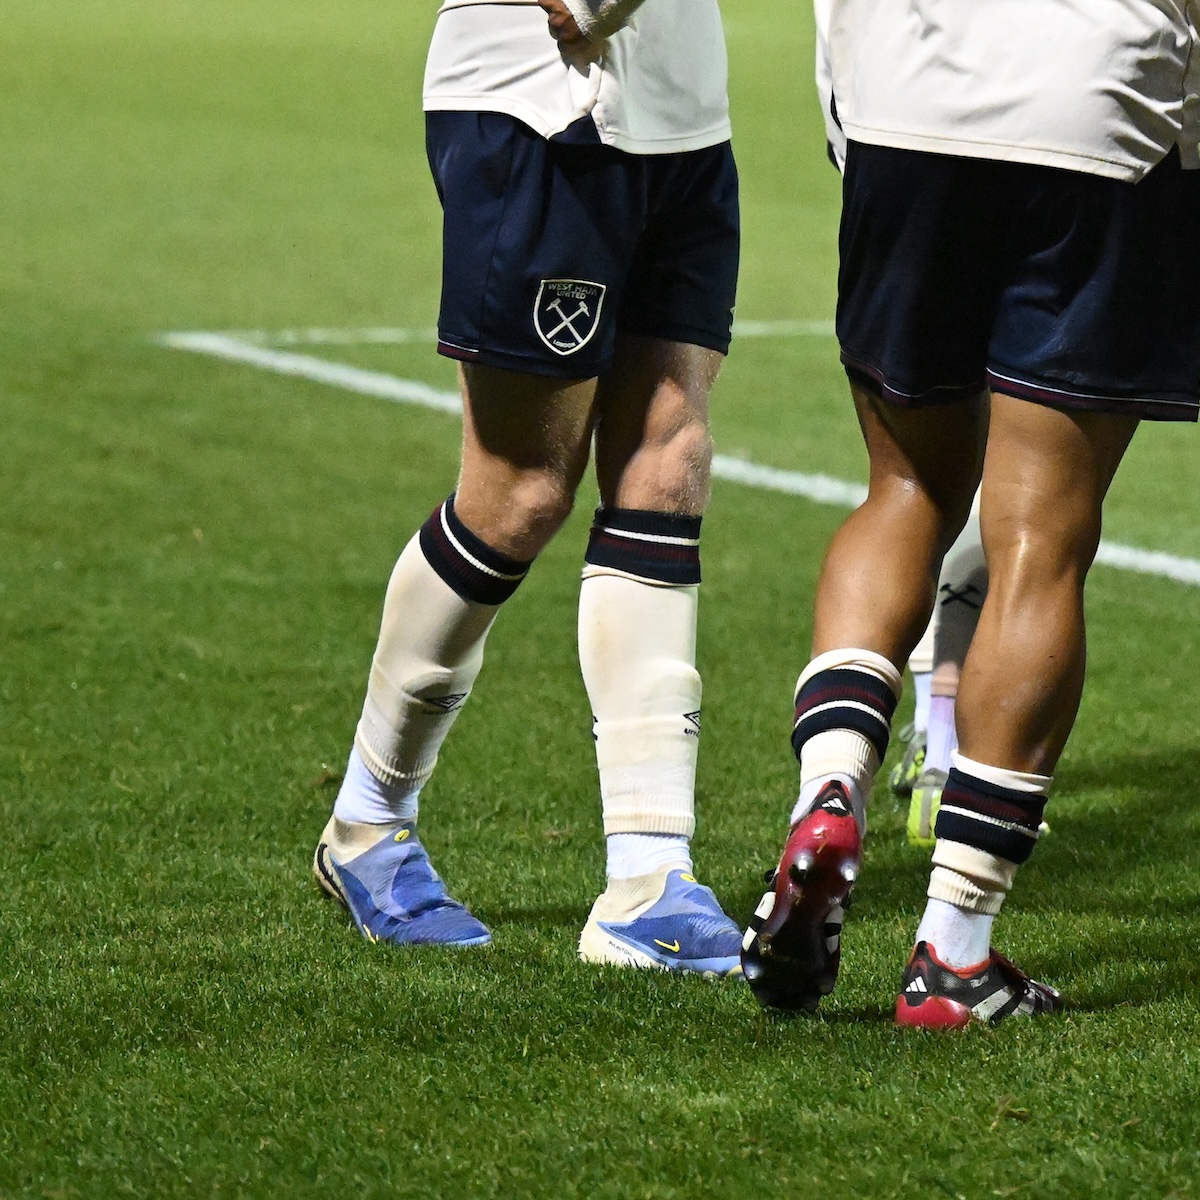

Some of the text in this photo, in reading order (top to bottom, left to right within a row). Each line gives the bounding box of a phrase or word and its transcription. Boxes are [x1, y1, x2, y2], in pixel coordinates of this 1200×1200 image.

[548, 283, 598, 297] WEST HAM
[556, 289, 587, 300] UNITED
[553, 339, 577, 349] LONDON
